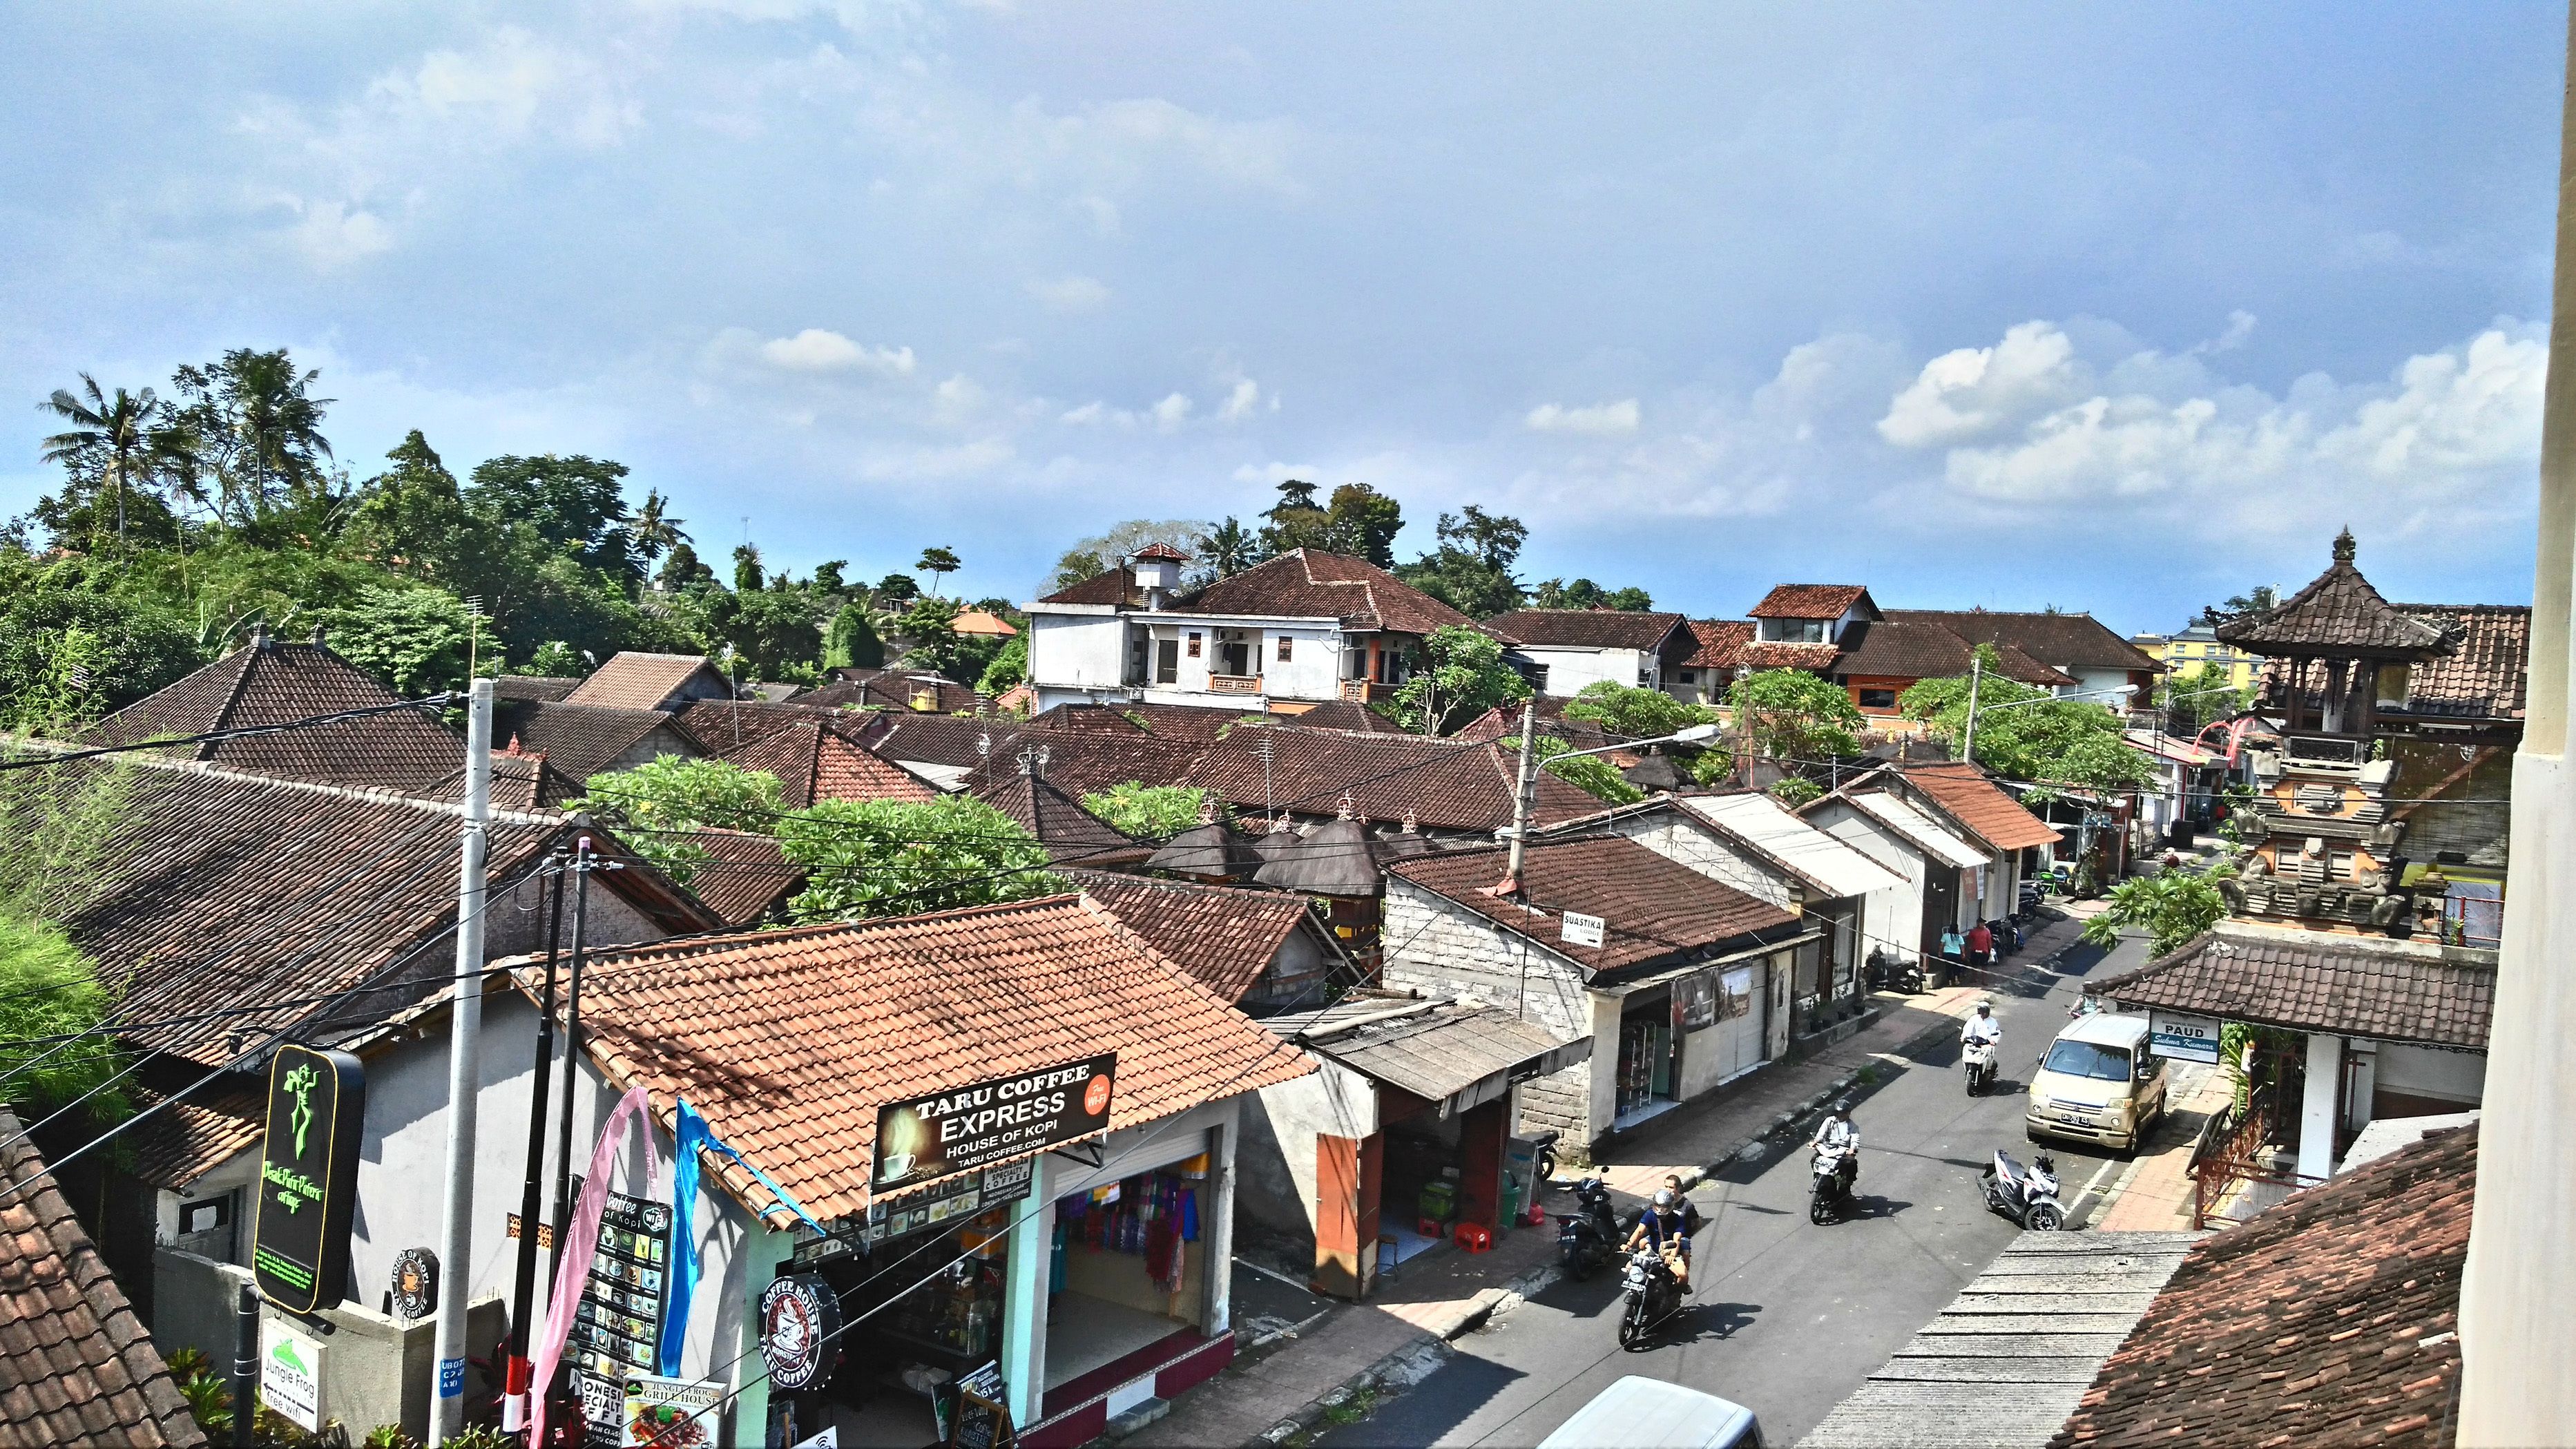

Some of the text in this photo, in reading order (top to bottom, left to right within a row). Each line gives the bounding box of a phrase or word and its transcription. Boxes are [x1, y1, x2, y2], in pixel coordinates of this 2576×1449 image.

[1564, 915, 1601, 930] SUASTIKA
[1579, 928, 1599, 937] LODGE
[2153, 1035, 2180, 1046] Sukma
[2165, 1025, 2204, 1037] PAUD
[916, 1064, 1090, 1120] TARU COFFEE
[1088, 1093, 1106, 1106] WI-FI
[940, 1092, 1066, 1142] EXPRESS
[946, 1119, 1057, 1158] HOUSE OF KOPI
[958, 1138, 1046, 1169] TARU COFFEE.COM
[988, 1158, 1028, 1175] INDONESIAN
[992, 1167, 1022, 1181] SPECIALTY
[986, 1171, 1027, 1189] COFFEE
[606, 1192, 636, 1221] Coffee
[604, 1211, 641, 1229] of Kopi
[392, 1249, 430, 1284] HOUSE OF KOPI
[393, 1291, 427, 1318] TARU COFFEE
[762, 1280, 818, 1334] COFFEE HOUSE
[760, 1334, 813, 1384] TARU COFFEE
[265, 1359, 314, 1399] Jungle Frog
[651, 1383, 711, 1397] JUNGLE FROG
[267, 1391, 301, 1420] free wifi
[644, 1389, 677, 1401] GRILL
[681, 1393, 720, 1406] HOUSE
